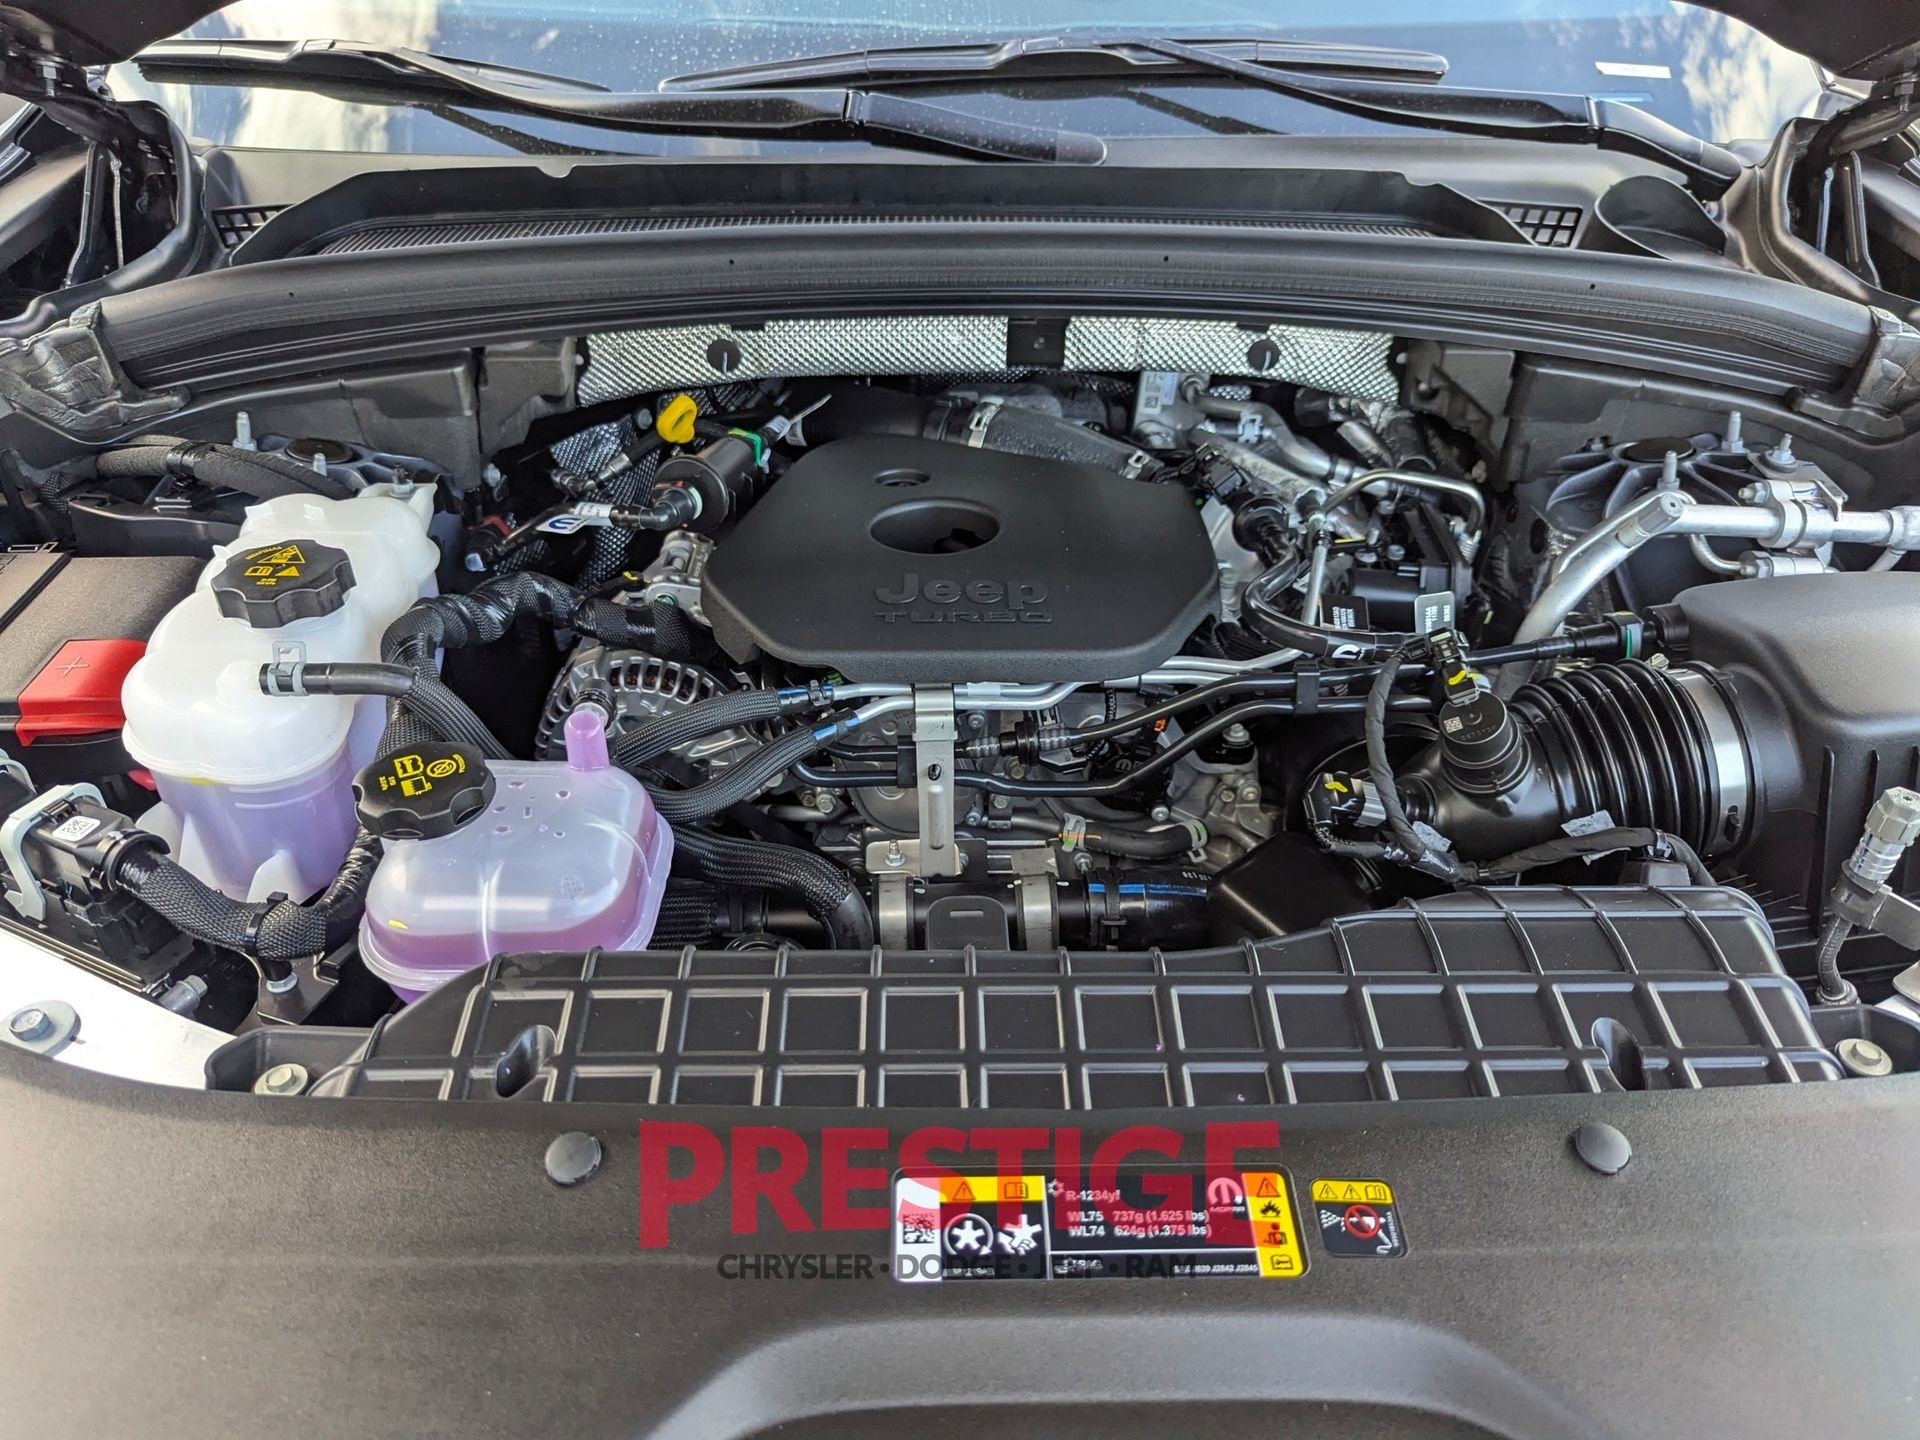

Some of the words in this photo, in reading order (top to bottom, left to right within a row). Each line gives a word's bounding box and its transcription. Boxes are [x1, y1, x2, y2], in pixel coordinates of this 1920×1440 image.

[875, 573, 1048, 611] Jeep
[872, 610, 1053, 624] TURBO
[1065, 1189, 1121, 1203] R-1234yf
[1066, 1211, 1105, 1224] WL75
[1112, 1211, 1145, 1225] 737g
[1068, 1225, 1106, 1239] WL74
[1113, 1225, 1147, 1239] 624g
